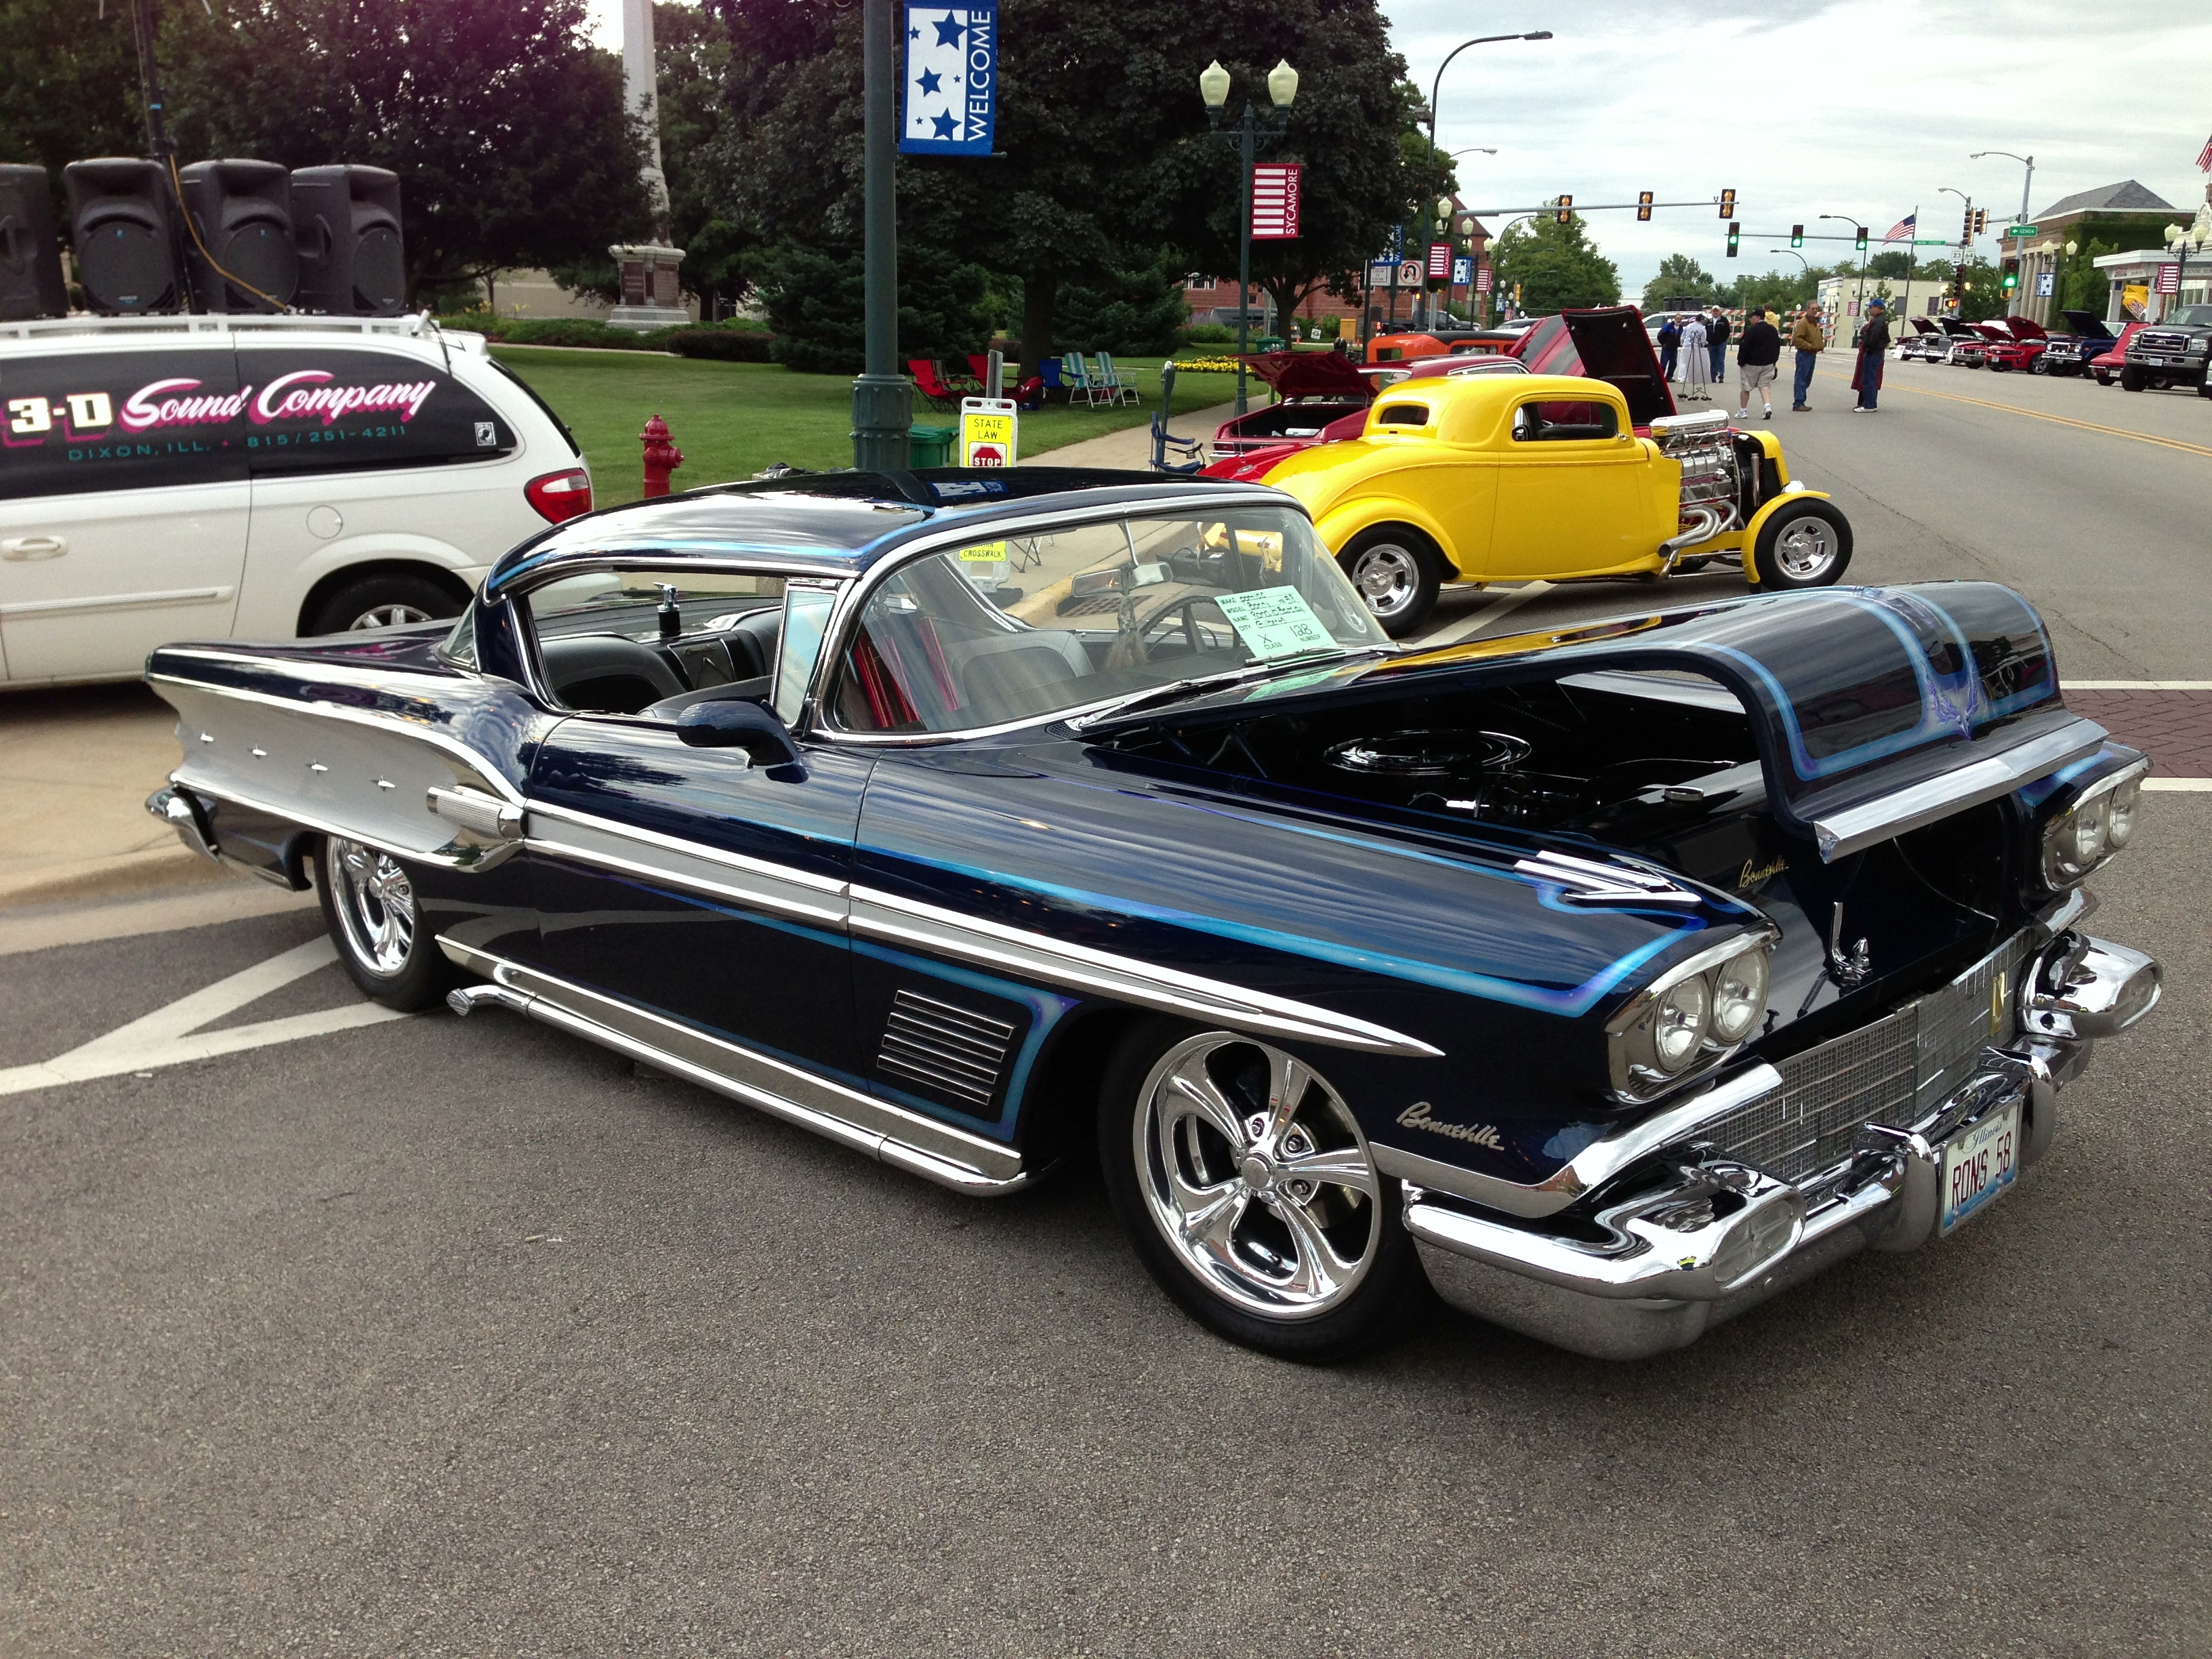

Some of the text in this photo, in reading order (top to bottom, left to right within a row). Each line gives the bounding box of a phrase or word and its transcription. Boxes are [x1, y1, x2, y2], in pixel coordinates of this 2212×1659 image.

[967, 10, 991, 142] WELCOME
[1286, 169, 1298, 234] SYCAMORE
[7, 369, 437, 435] 3-D Sound Company
[974, 418, 1003, 429] STATE
[978, 430, 998, 440] LAW
[167, 441, 211, 453] ILL.
[974, 457, 1000, 466] STOP
[963, 550, 1002, 558] CROSSWALK
[1264, 634, 1321, 650] CLASS NUMBER
[1289, 623, 1313, 637] 128
[1738, 855, 1789, 888] Bonneville
[1396, 1101, 1505, 1151] Bonneville
[1962, 1121, 2003, 1154] Illinois
[1951, 1148, 1988, 1210] RONS
[1994, 1130, 2012, 1179] 58
